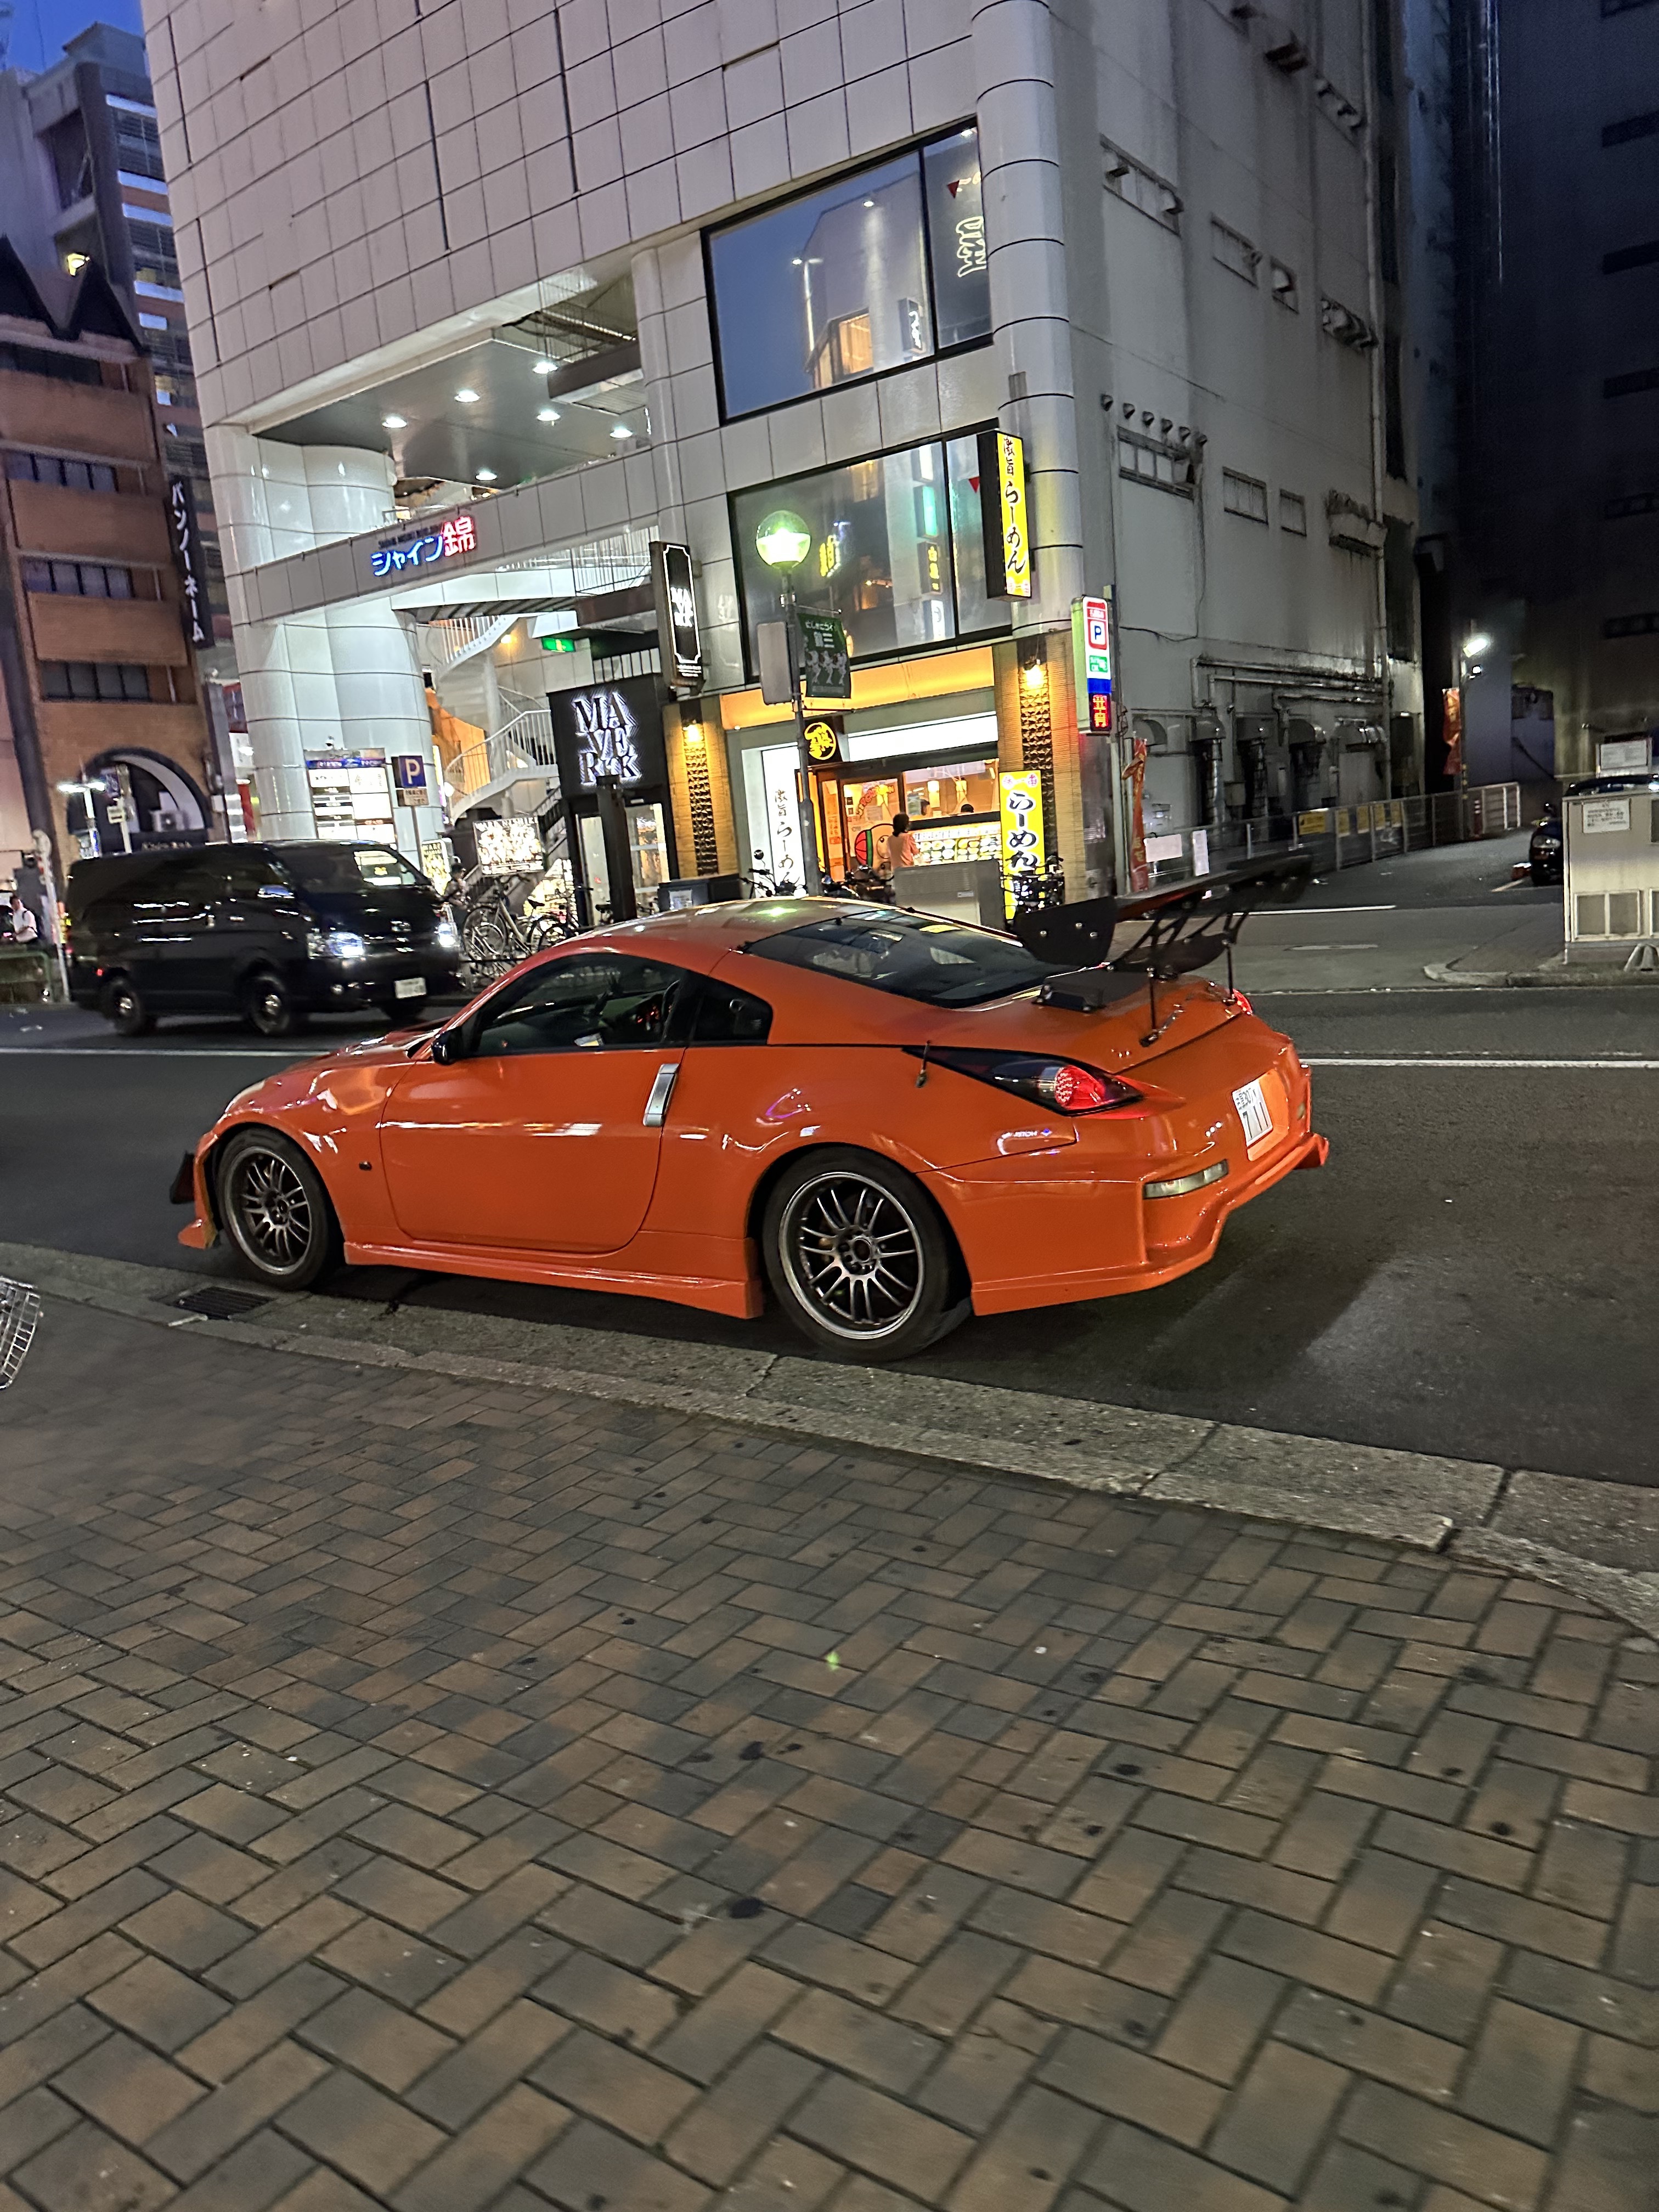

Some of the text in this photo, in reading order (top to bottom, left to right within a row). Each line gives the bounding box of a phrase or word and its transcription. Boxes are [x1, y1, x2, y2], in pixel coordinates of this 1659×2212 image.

[371, 516, 477, 576] シャイン錦
[1094, 625, 1101, 640] P
[574, 691, 630, 733] MA
[405, 759, 420, 785] P
[1005, 792, 1039, 869] らーめん
